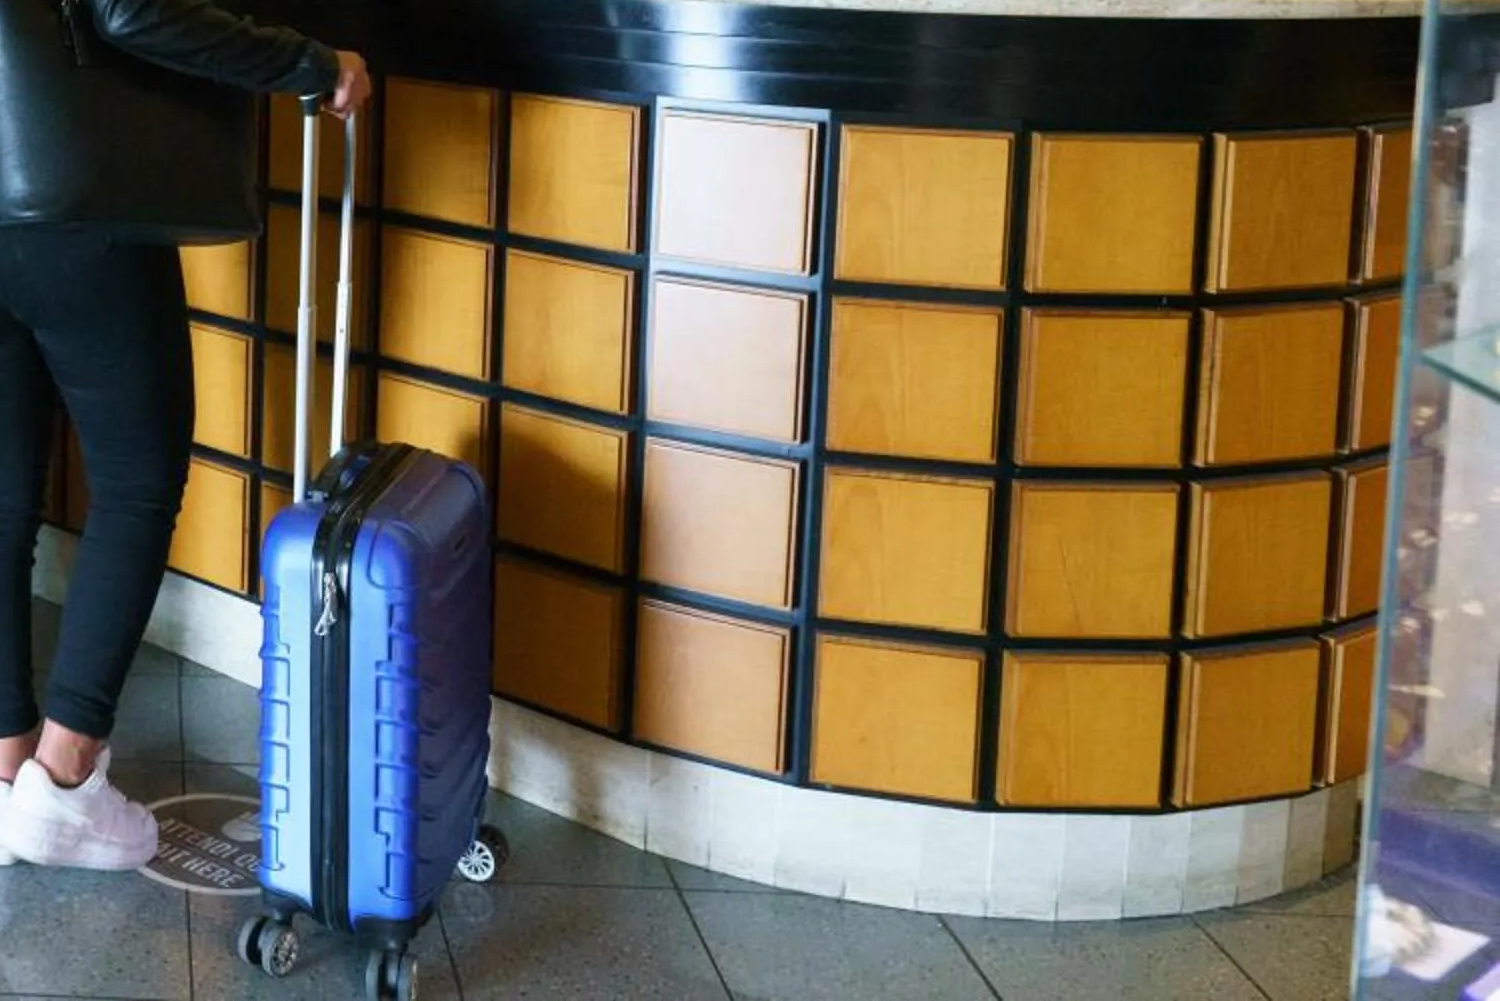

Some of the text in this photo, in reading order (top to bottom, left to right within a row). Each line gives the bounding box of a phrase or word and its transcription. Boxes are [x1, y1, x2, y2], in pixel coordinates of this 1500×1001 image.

[156, 841, 245, 888] AIT HERE
[158, 817, 262, 872] ATTENDI QU
